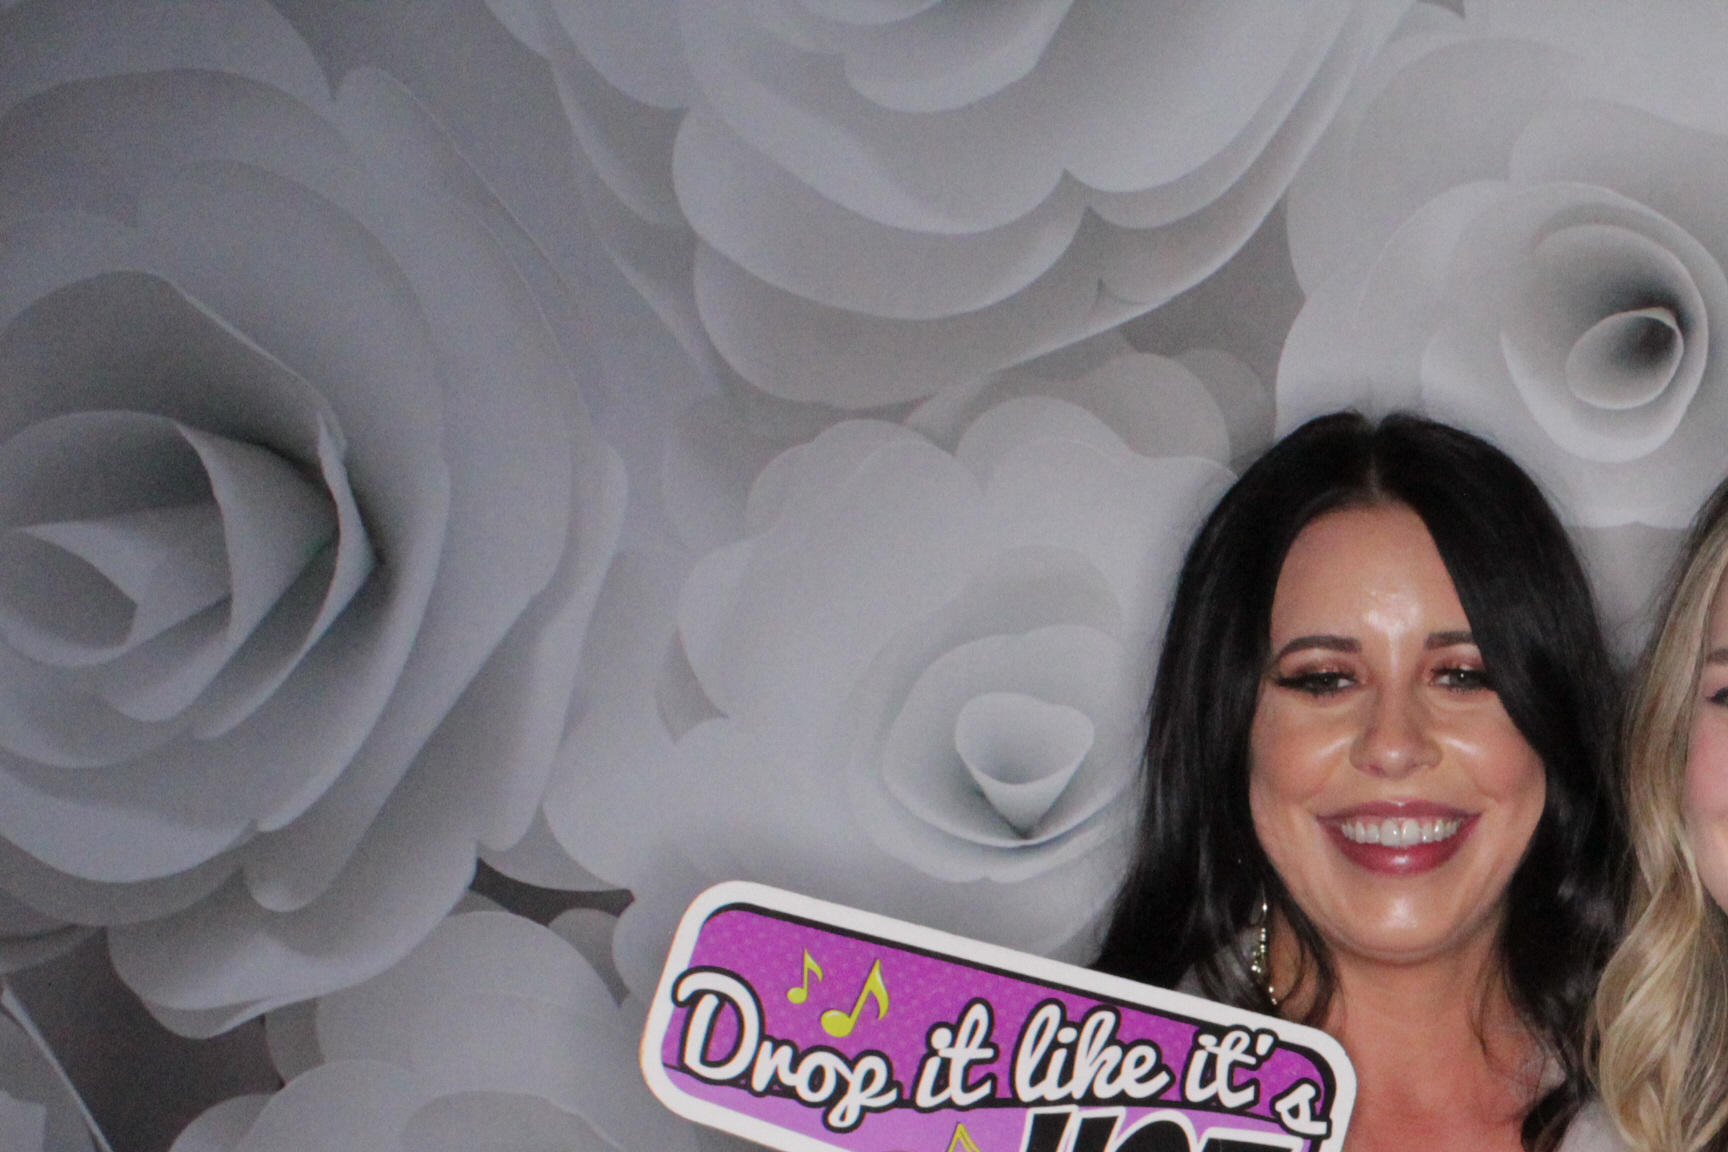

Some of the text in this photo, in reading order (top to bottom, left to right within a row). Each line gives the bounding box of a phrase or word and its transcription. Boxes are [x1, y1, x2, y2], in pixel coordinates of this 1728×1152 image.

[675, 970, 1329, 1136] Drop it like it's
